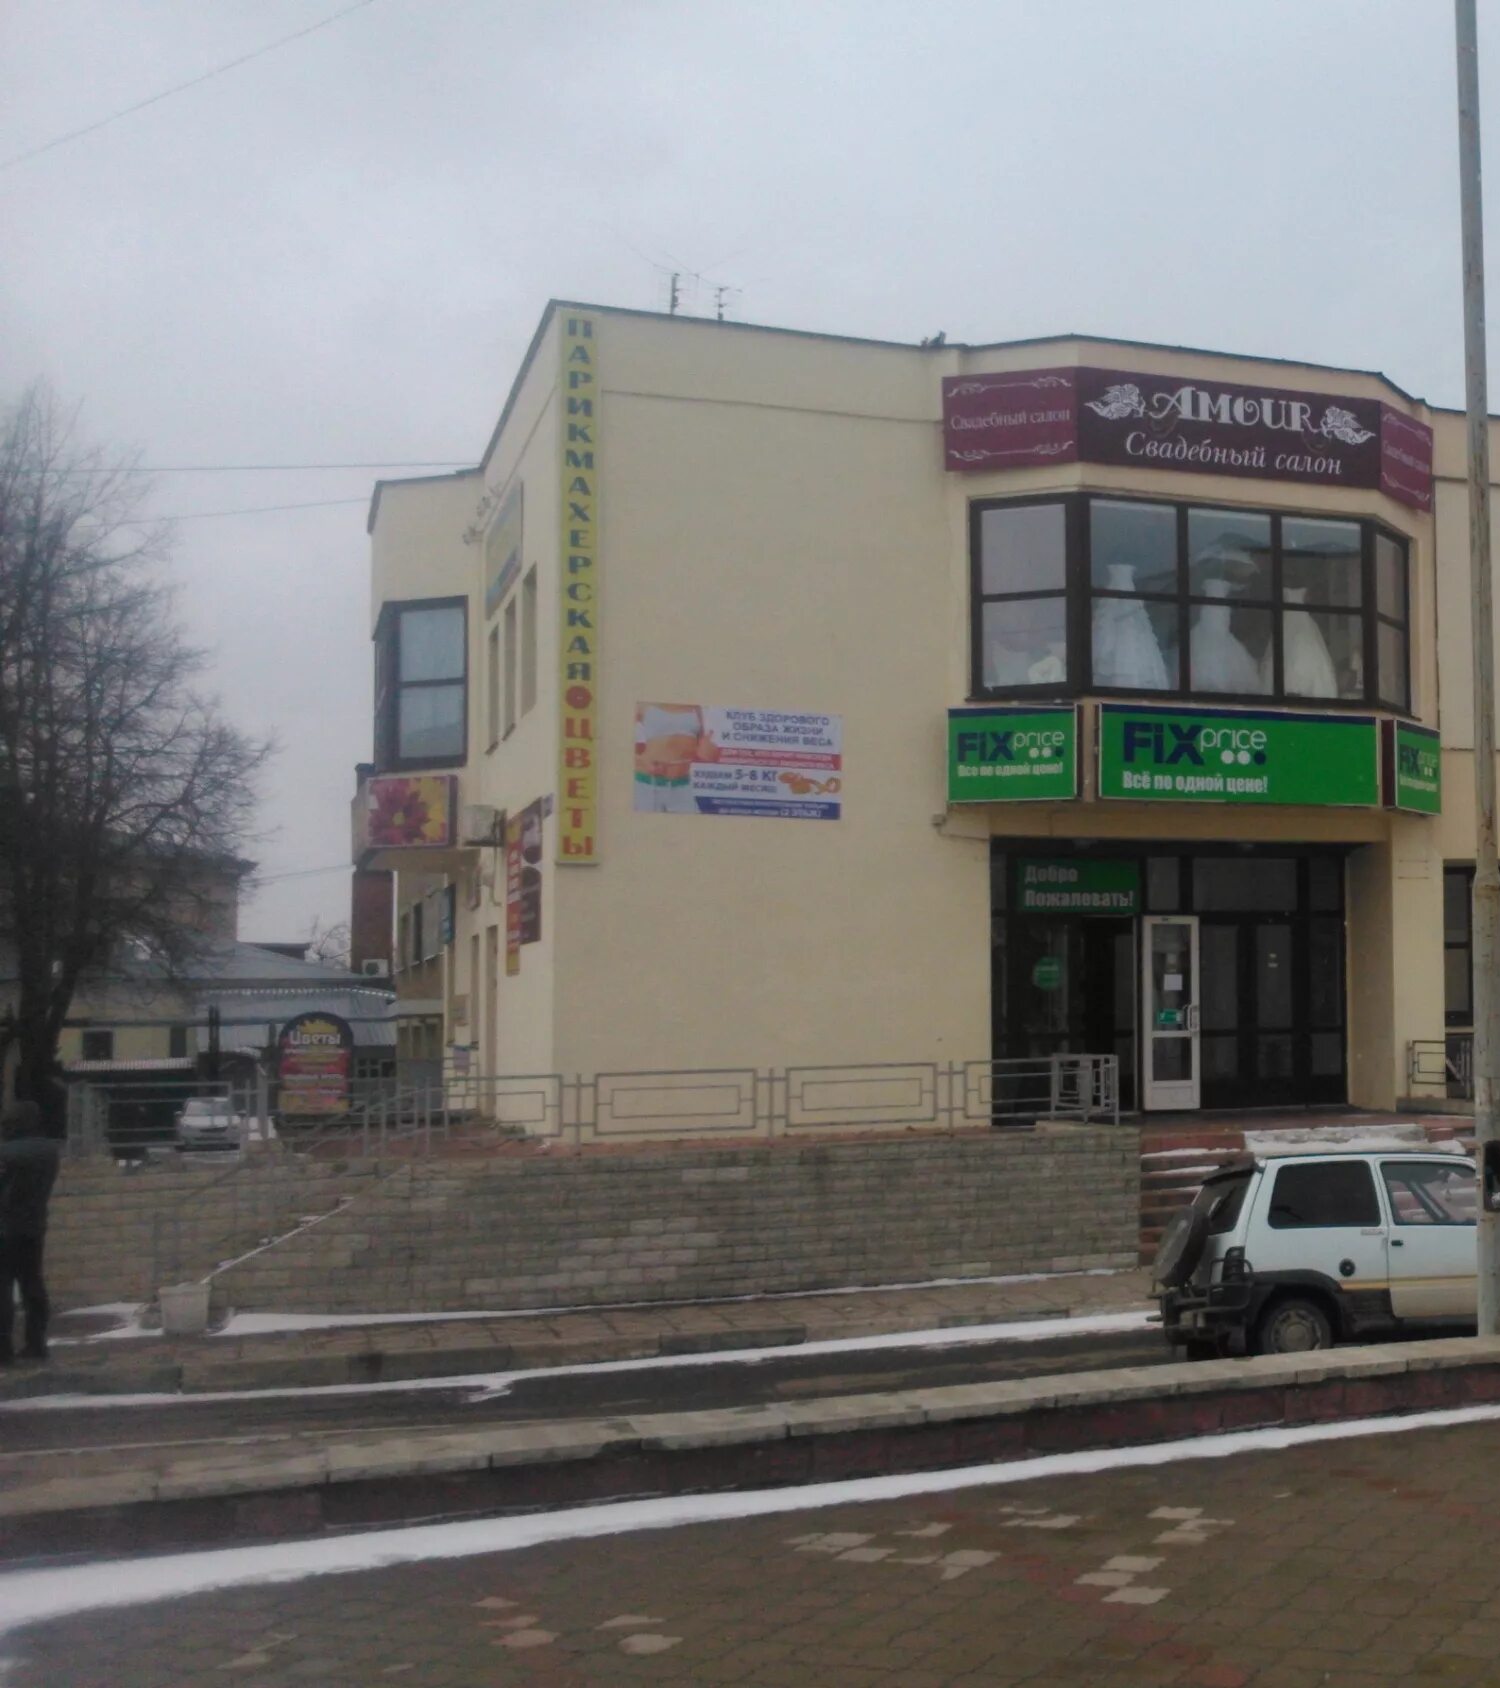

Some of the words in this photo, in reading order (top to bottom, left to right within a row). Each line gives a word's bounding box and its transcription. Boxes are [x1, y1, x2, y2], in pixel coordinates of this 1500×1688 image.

[951, 410, 1027, 431] Свадебный
[1030, 409, 1070, 424] салон
[1126, 431, 1267, 468] Свадебный
[1275, 453, 1342, 475] салон
[565, 318, 594, 681] ПАРИКМАХЕРСКАЯ
[726, 711, 756, 722] КЛУБ
[760, 713, 830, 726] ЗДОРОВОГО
[733, 722, 779, 733] ОБРАЗА
[783, 725, 824, 736] ЖИЗНИ
[722, 732, 730, 741] И
[733, 734, 800, 745] СНИЖЕНИЯ
[803, 736, 834, 747] ВЕСА
[1013, 730, 1065, 750] price
[1200, 727, 1268, 753] price
[564, 717, 594, 856] ЦВЕТЫ
[1123, 770, 1151, 789] Всё
[1153, 774, 1173, 790] по
[1175, 774, 1224, 793] одной
[1226, 775, 1269, 795] цене!
[1025, 865, 1079, 883] Добро
[1025, 890, 1135, 909] Пожаловать!
